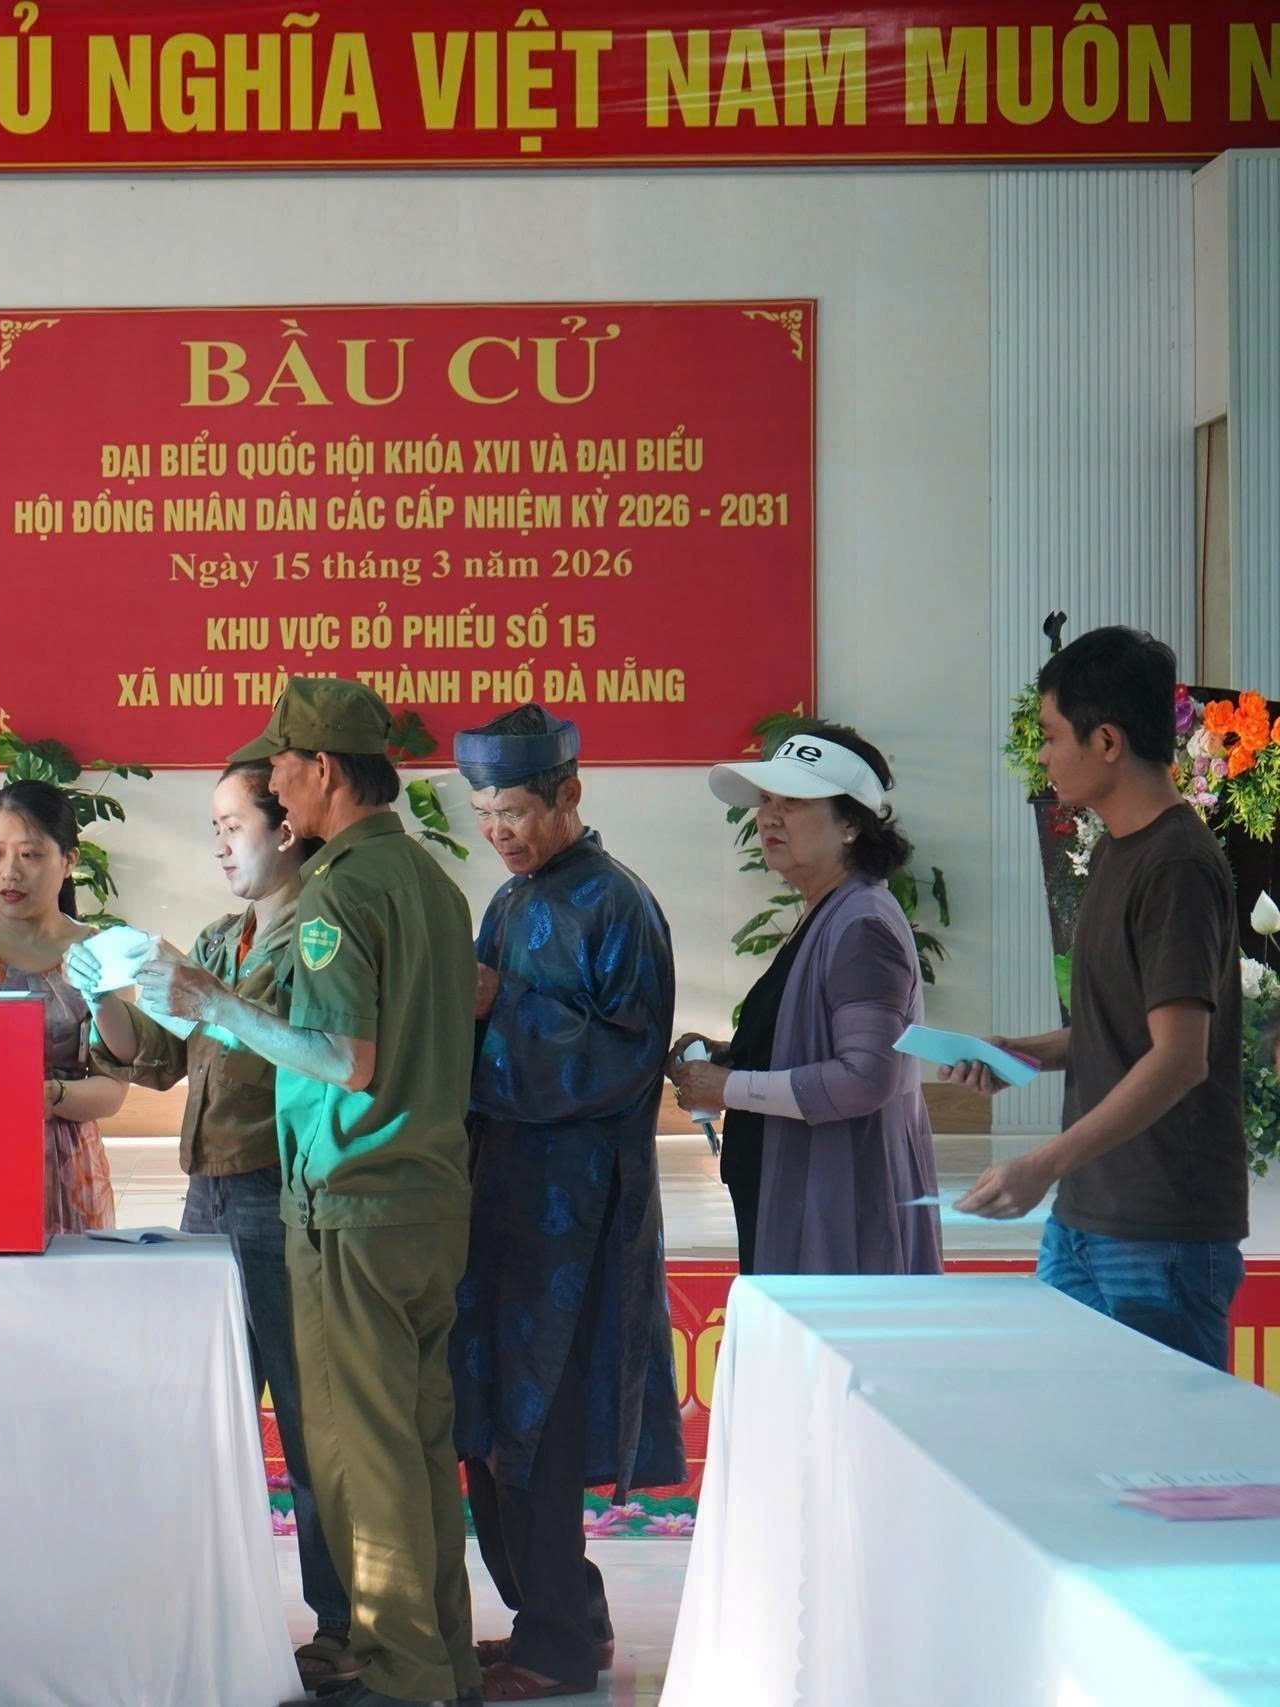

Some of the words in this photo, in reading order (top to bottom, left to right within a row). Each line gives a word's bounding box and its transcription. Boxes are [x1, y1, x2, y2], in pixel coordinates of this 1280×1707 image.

[88, 13, 381, 133] NGHĨA
[412, 10, 613, 152] VIỆT
[646, 28, 867, 127] NAM
[905, 3, 1191, 126] MUÔN
[181, 319, 415, 407] BẦU
[447, 316, 621, 404] CỬ
[101, 444, 151, 485] ĐẠI
[161, 429, 227, 477] BIỂU
[237, 431, 316, 480] QUỐC
[325, 435, 374, 481] HỘI
[384, 434, 463, 474] KHÓA
[473, 440, 520, 473] XVI
[530, 434, 568, 473] VÀ
[577, 439, 626, 479] ĐẠI
[636, 426, 703, 471] BIỂU
[14, 493, 63, 541] HỘI
[72, 489, 153, 534] ĐỒNG
[163, 491, 245, 532] NHÂN
[256, 491, 316, 531] DÂN
[326, 489, 386, 531] CÁC
[395, 485, 455, 530] CẤP
[464, 488, 561, 536] NHIỆM
[571, 487, 609, 528] KỲ
[618, 494, 690, 527] 2026
[720, 493, 789, 526] 2031
[169, 552, 259, 588] Ngày
[273, 552, 310, 580] 15
[322, 551, 422, 586] tháng
[432, 550, 451, 578] 3
[464, 551, 539, 578] năm
[552, 549, 633, 577] 2026
[207, 617, 269, 651] KHU
[279, 613, 340, 657] VỰC
[351, 601, 392, 649] BỎ
[403, 603, 495, 649] PHIẾU
[506, 602, 550, 648] SỐ
[559, 615, 596, 647] 15
[117, 666, 160, 707] XÃ
[169, 666, 224, 707] NÚI
[233, 665, 337, 706] THÀ
[471, 659, 535, 704] PHỐ
[543, 662, 587, 703] ĐÀ
[596, 656, 686, 703] NẴNG
